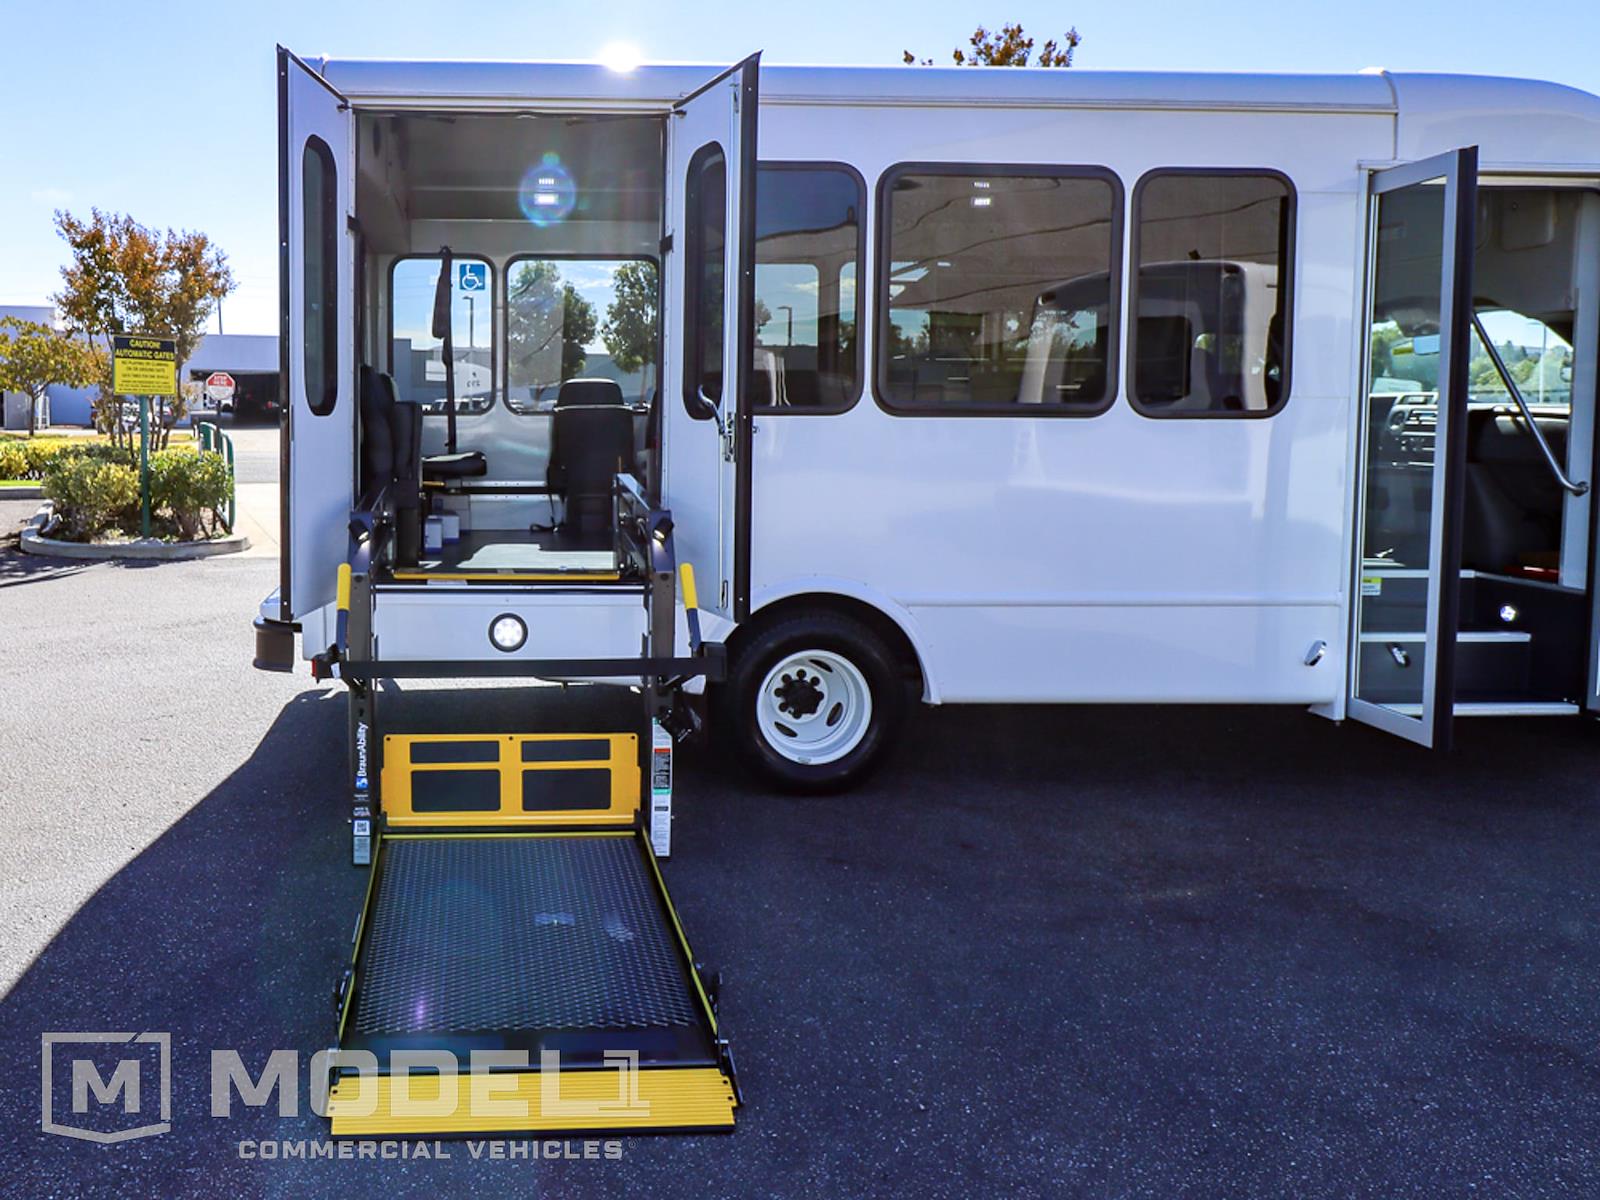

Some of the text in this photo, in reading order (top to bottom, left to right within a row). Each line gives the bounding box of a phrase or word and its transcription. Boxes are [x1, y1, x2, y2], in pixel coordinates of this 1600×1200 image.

[115, 349, 175, 360] AUTOMATIC GATES
[356, 722, 369, 777] BraunAbility
